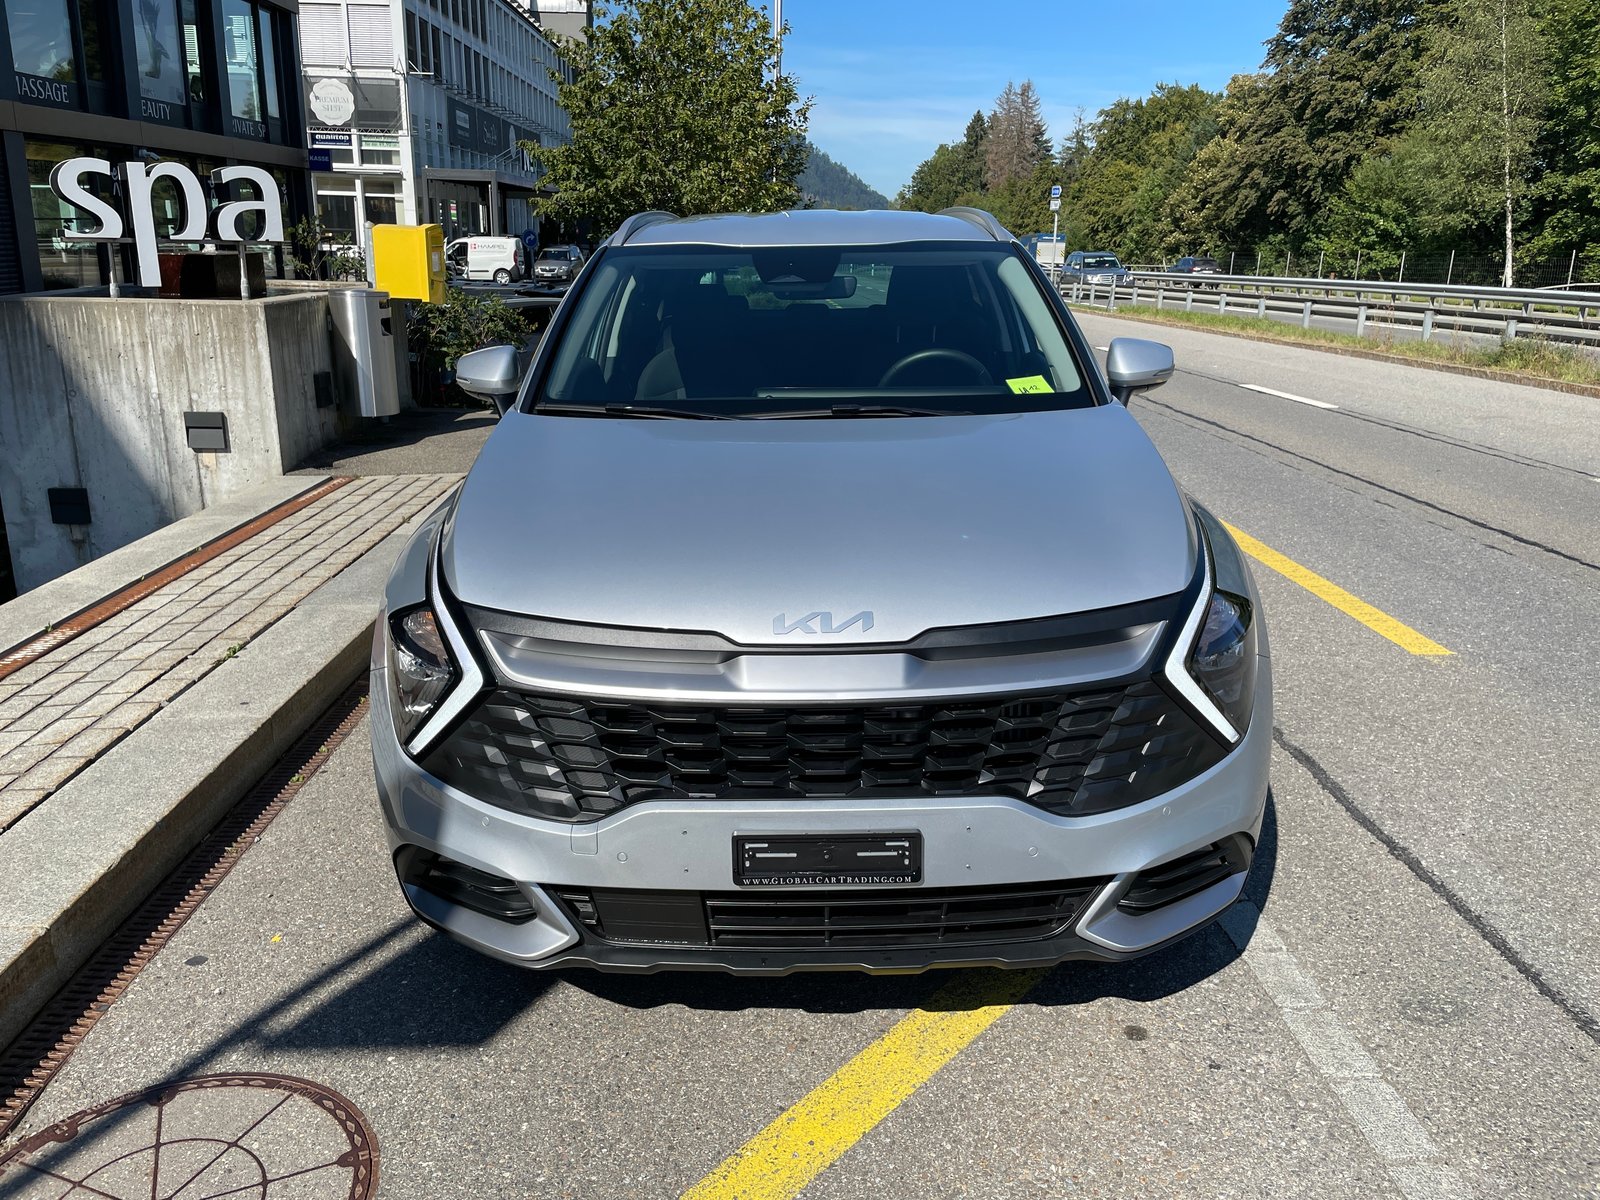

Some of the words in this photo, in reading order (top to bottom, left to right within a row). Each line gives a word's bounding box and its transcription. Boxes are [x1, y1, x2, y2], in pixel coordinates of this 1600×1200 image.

[141, 99, 171, 121] EAUTY
[49, 156, 285, 288] spa
[772, 610, 875, 636] KIA
